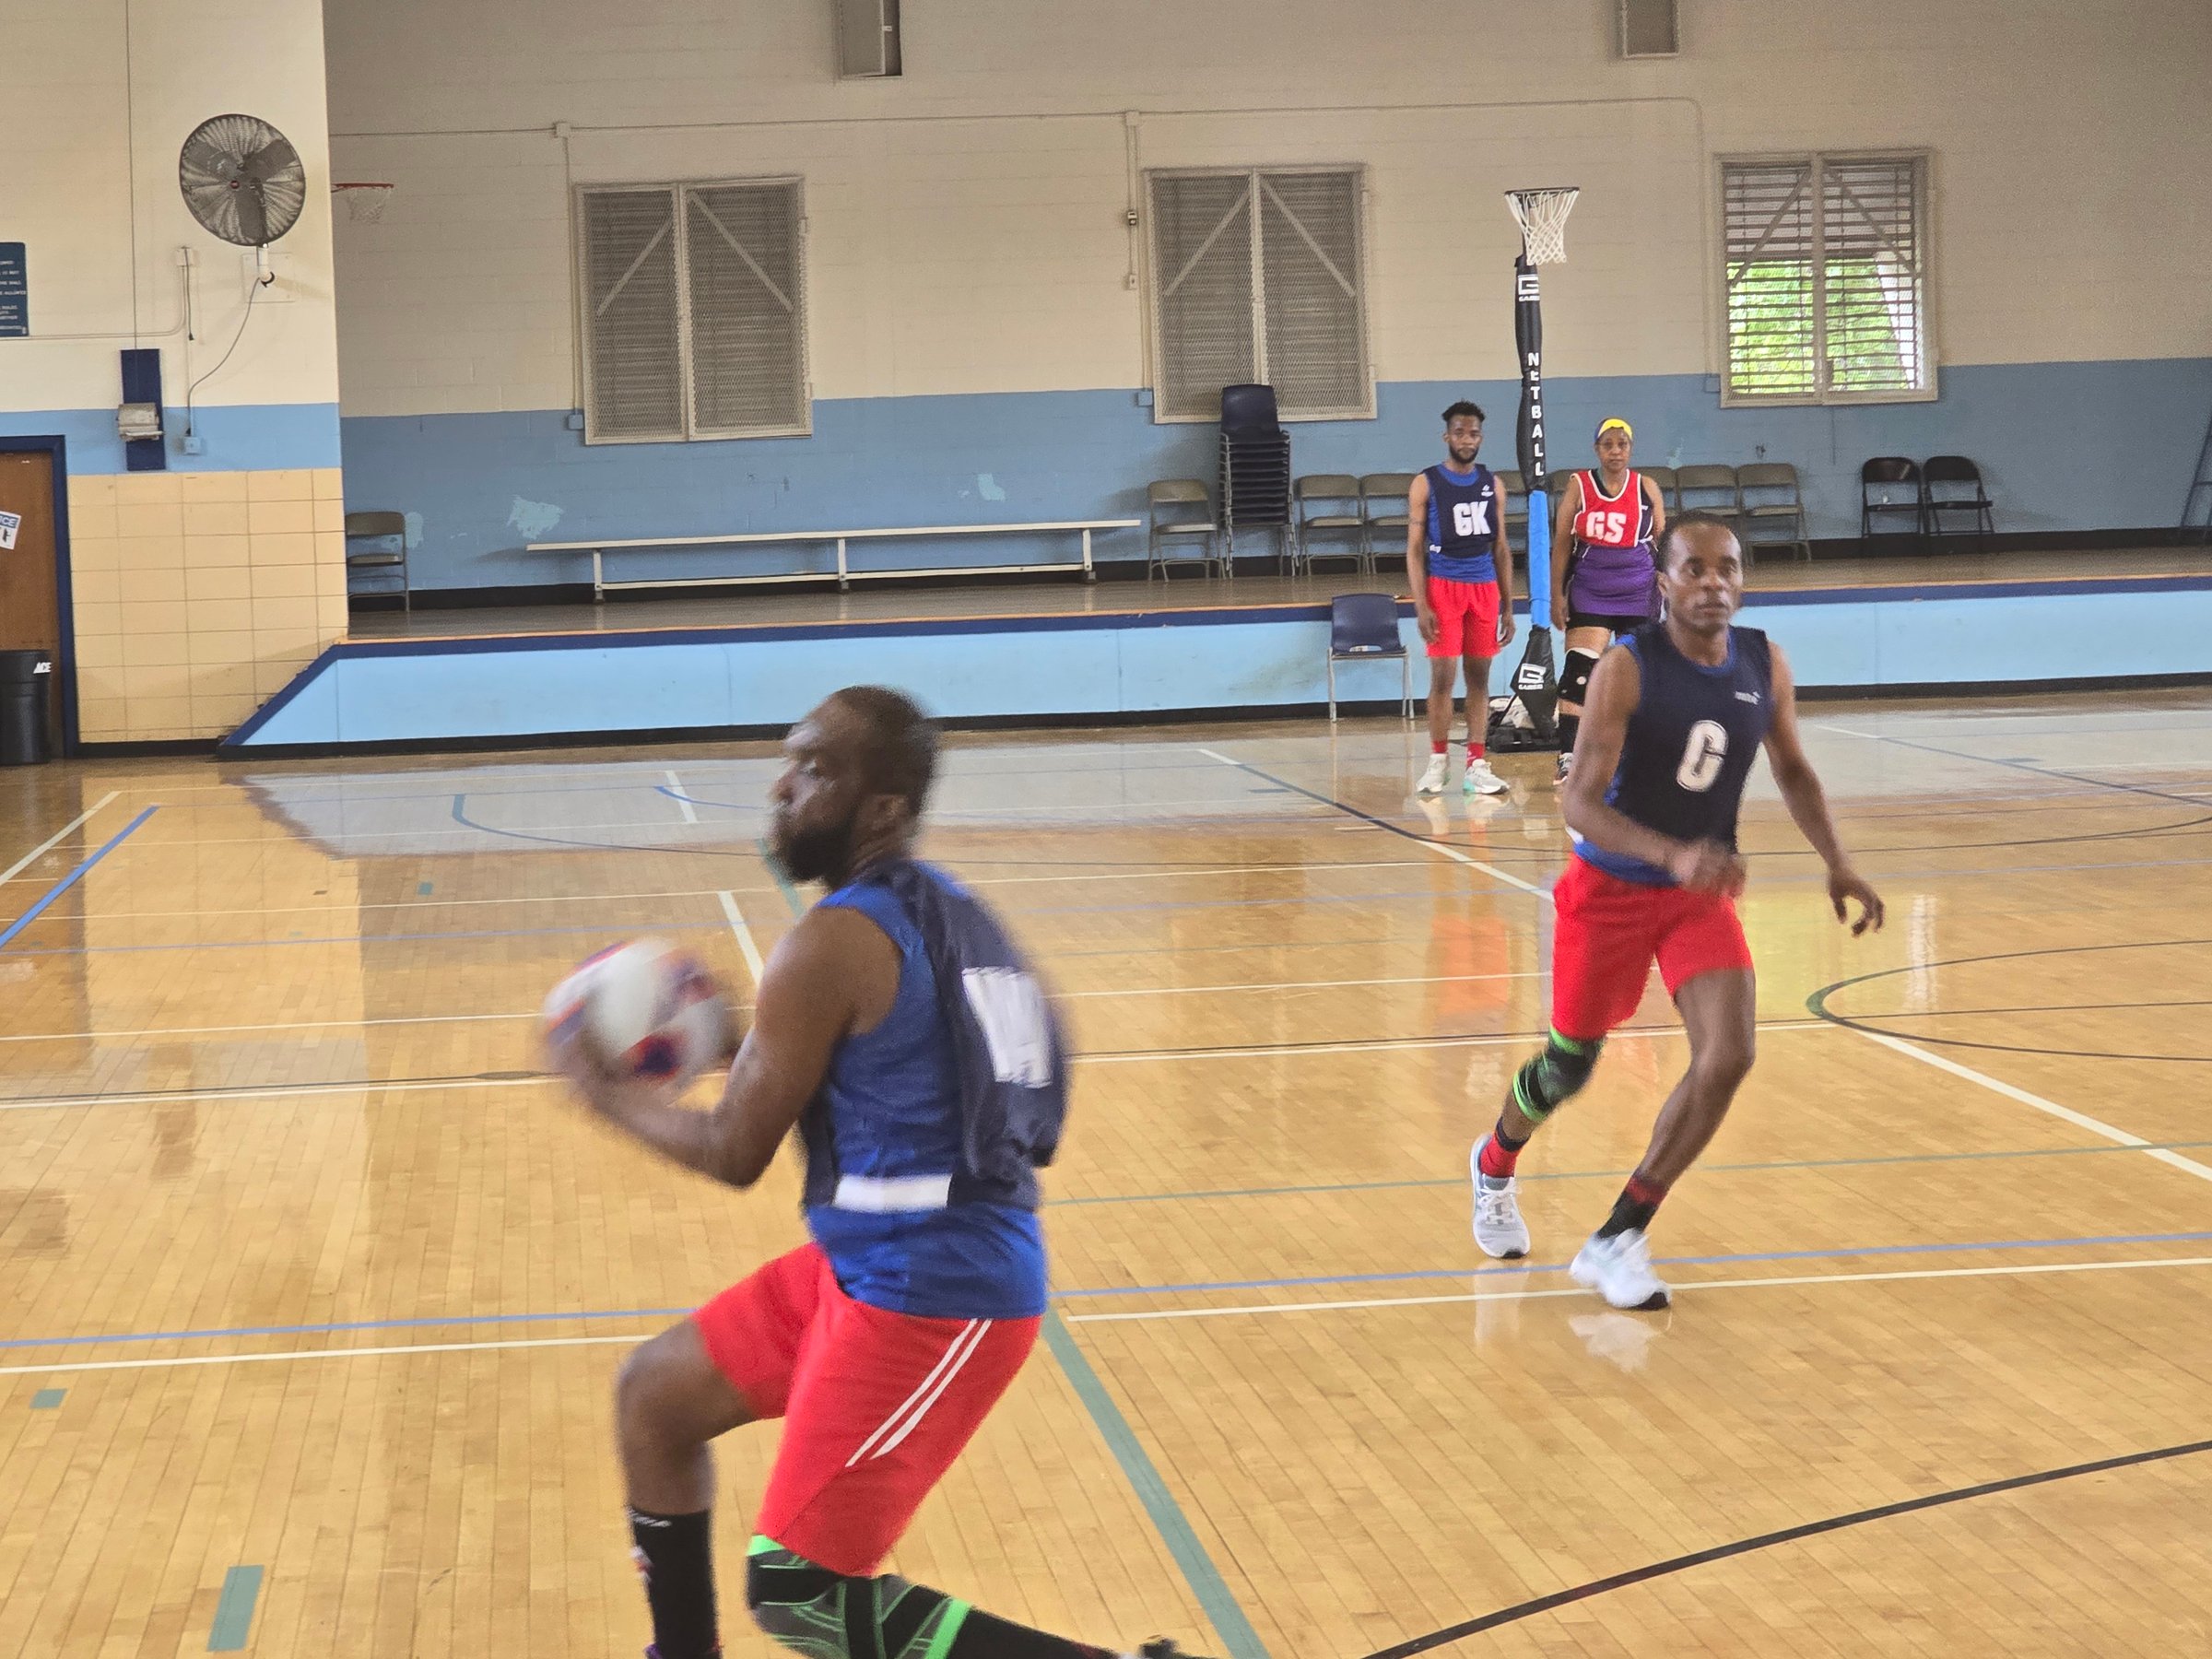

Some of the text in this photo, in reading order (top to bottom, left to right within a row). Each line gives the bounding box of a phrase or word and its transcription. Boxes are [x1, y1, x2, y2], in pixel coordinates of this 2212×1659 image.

[1528, 352, 1545, 476] NETBALL
[1453, 500, 1491, 536] GK
[1586, 511, 1627, 544] GS
[33, 662, 53, 674] ACE
[1676, 719, 1729, 793] C
